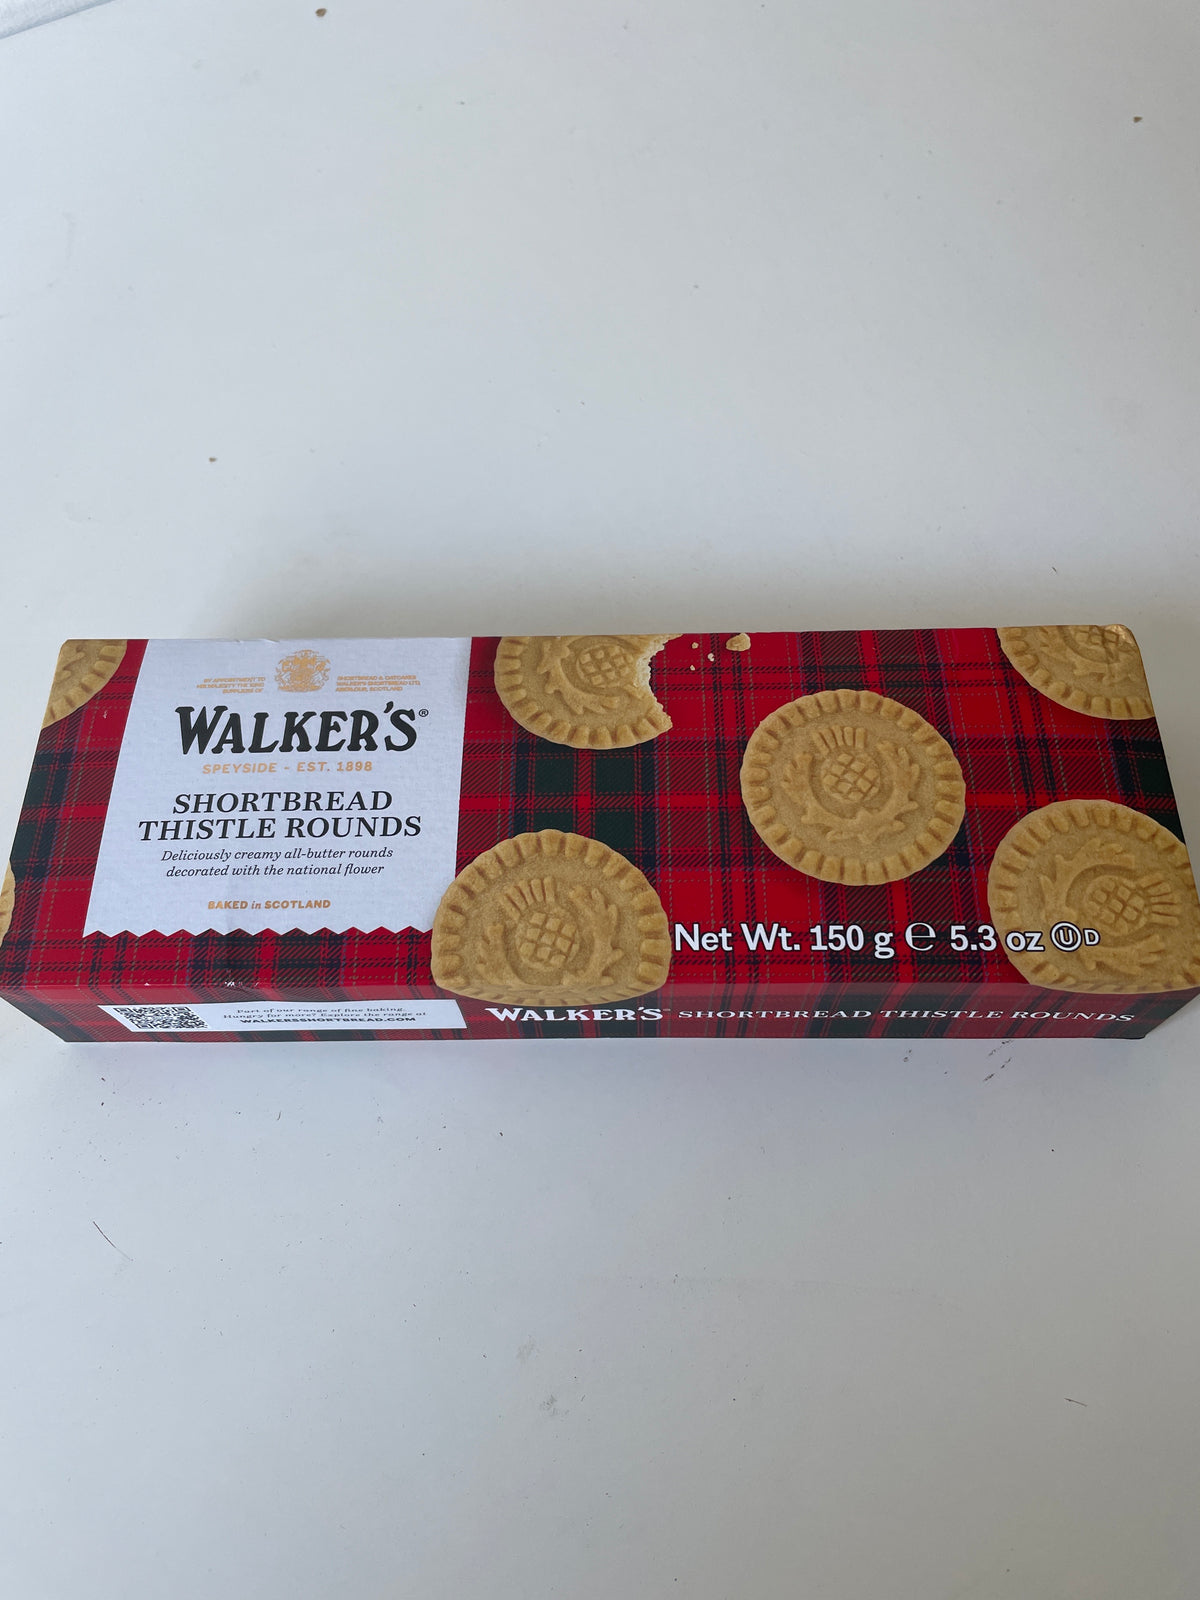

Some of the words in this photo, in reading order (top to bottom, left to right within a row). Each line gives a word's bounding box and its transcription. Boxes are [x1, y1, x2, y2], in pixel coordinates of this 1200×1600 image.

[202, 762, 278, 775] SPEYSIDE
[297, 761, 331, 773] EST.
[336, 761, 373, 772] 1898
[172, 790, 393, 815] SHORTBREAD
[138, 818, 276, 842] THISTLE
[284, 815, 421, 838] ROUNDS
[161, 849, 232, 862] Deliciously
[234, 849, 281, 861] creamy
[284, 848, 346, 860] all-butter
[348, 847, 394, 859] rounds
[166, 865, 230, 877] decorated
[232, 864, 260, 876] with
[264, 864, 284, 876] the
[286, 863, 342, 875] national
[344, 863, 385, 876] flower
[208, 900, 248, 910] BAKED
[251, 901, 262, 910] in
[264, 899, 331, 910] SCOTLAND
[674, 923, 733, 951] Net
[740, 923, 801, 951] Wt.
[810, 924, 865, 951] 150
[873, 931, 895, 959] g
[950, 925, 998, 951] 5.3
[1005, 931, 1045, 951] oz
[678, 1009, 873, 1019] SHORTBREAD
[879, 1010, 1003, 1020] THISTLE
[1009, 1010, 1136, 1022] ROUNDS
